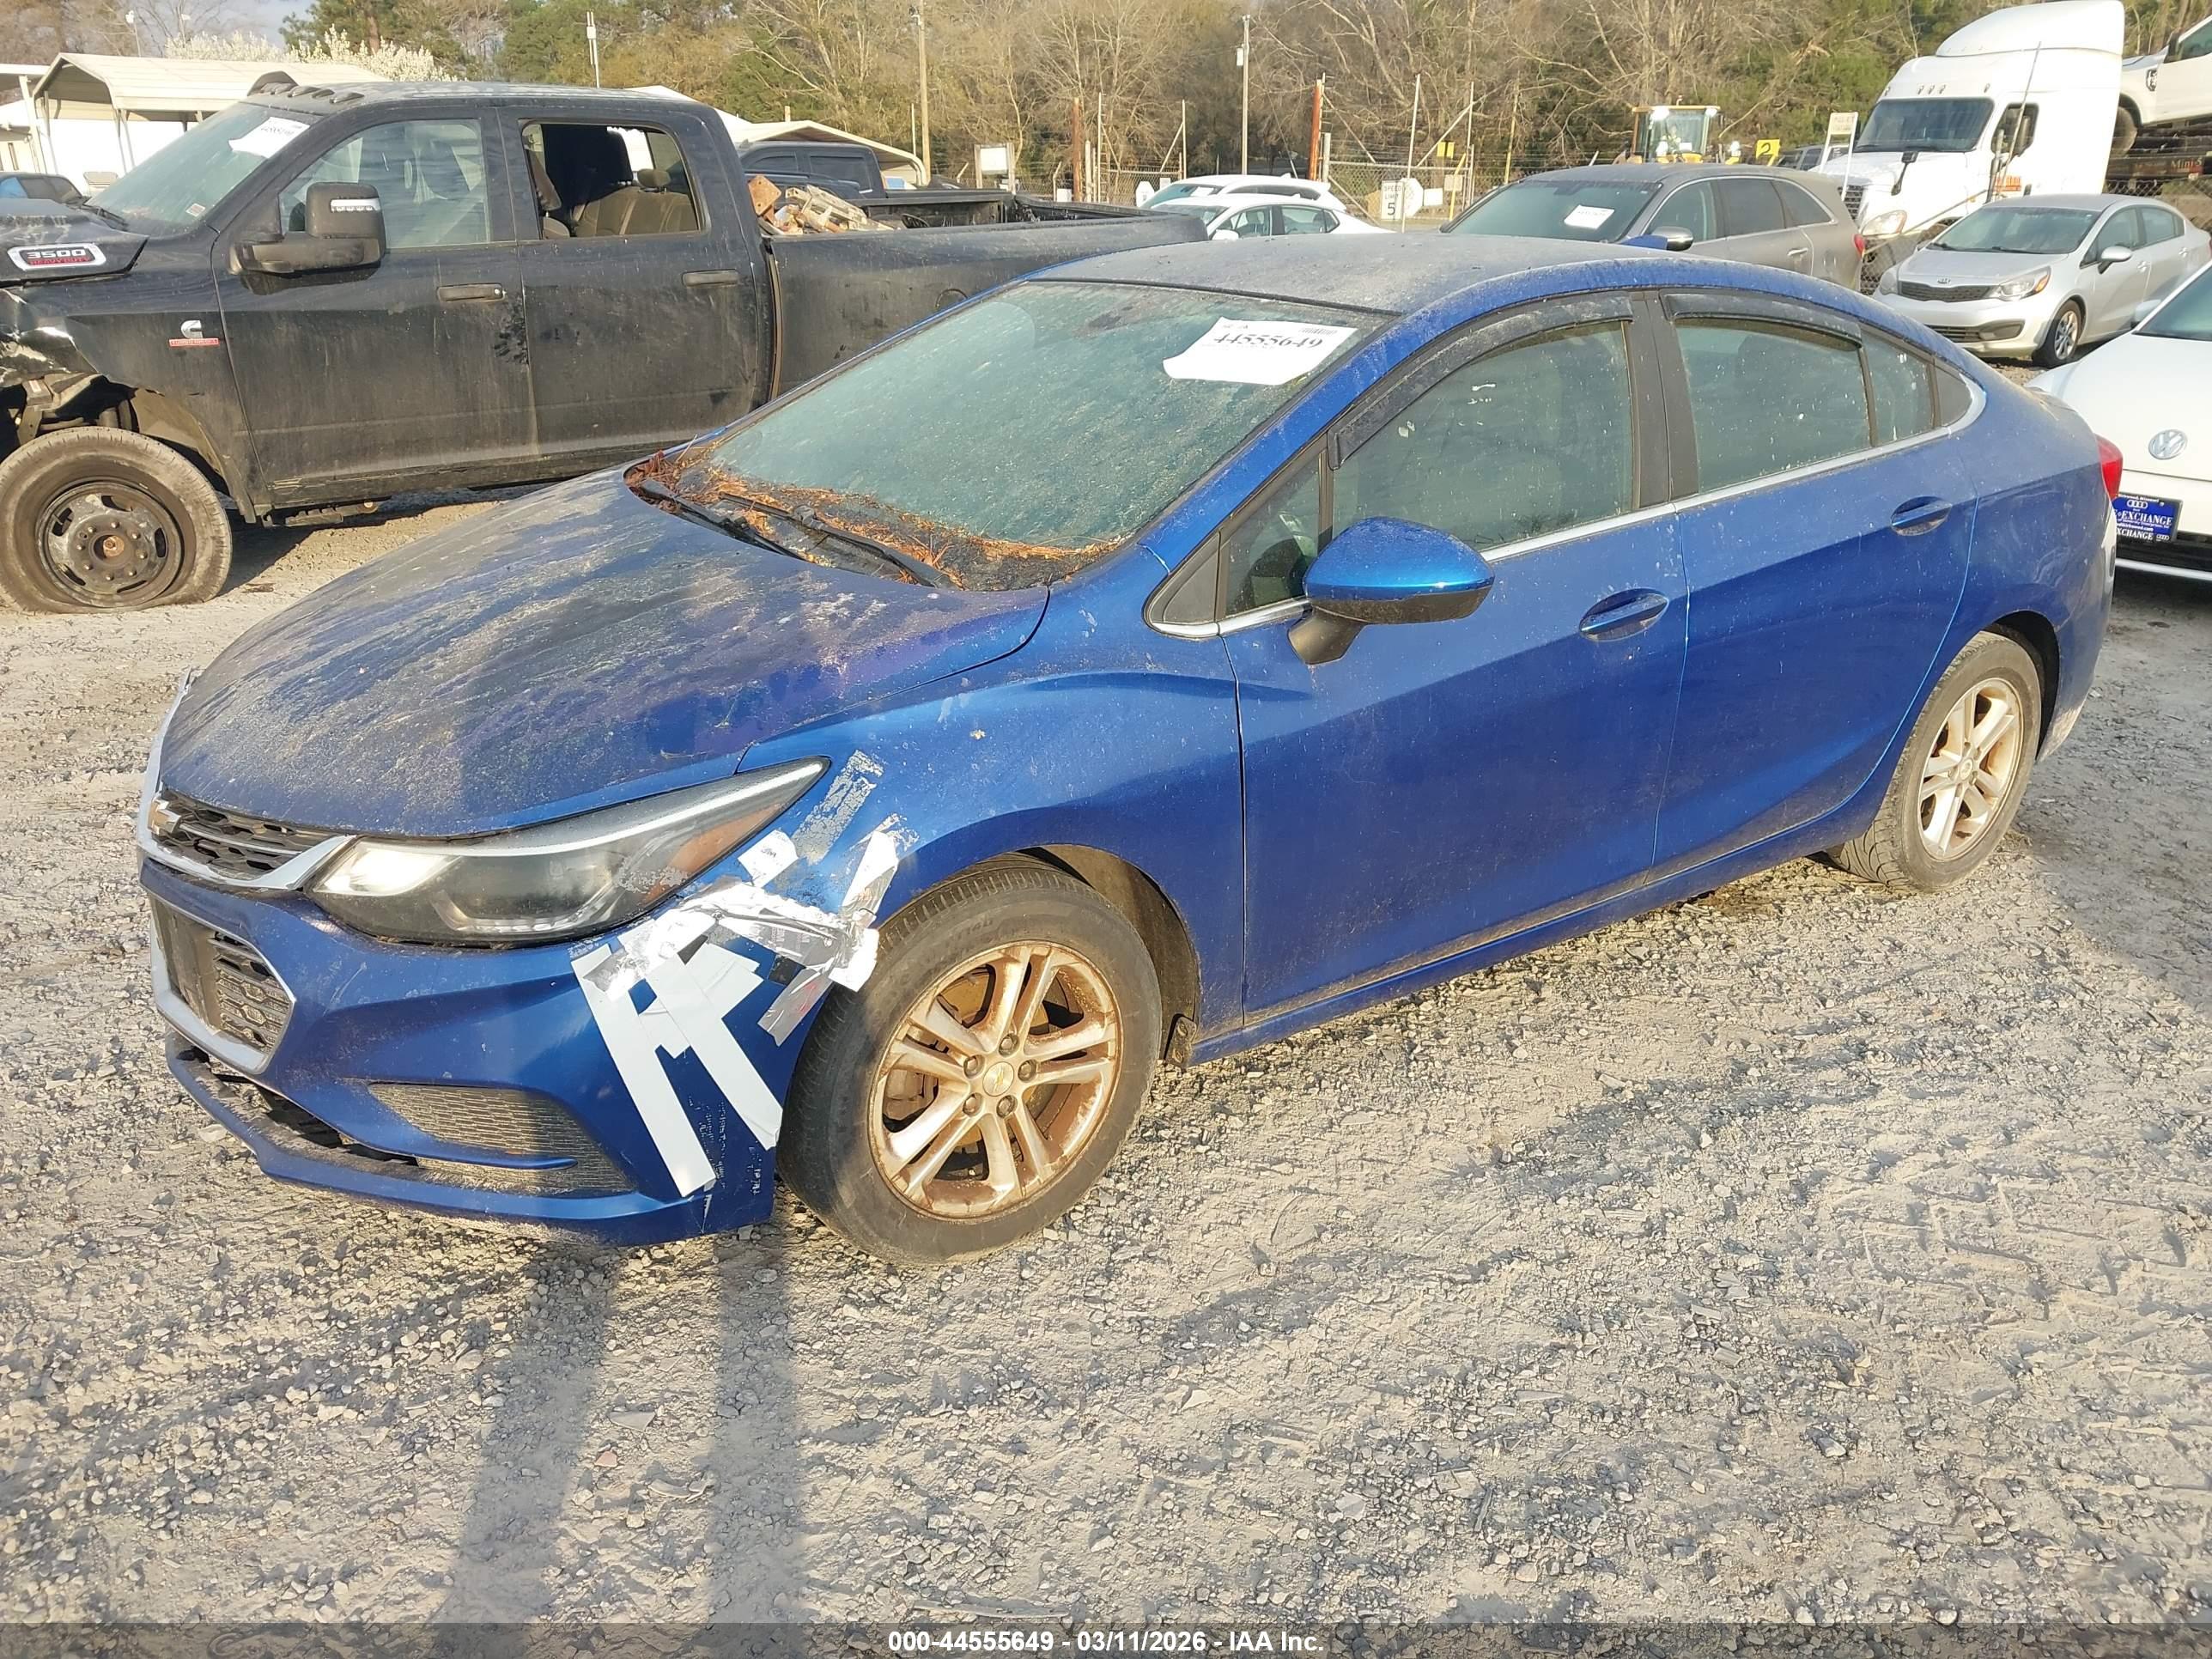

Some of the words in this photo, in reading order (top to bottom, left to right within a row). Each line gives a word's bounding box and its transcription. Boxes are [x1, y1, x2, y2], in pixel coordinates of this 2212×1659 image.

[1388, 203, 1395, 216] 5
[27, 248, 87, 259] 3500
[1213, 332, 1323, 349] 44555649
[2117, 527, 2154, 540] XCHANGE
